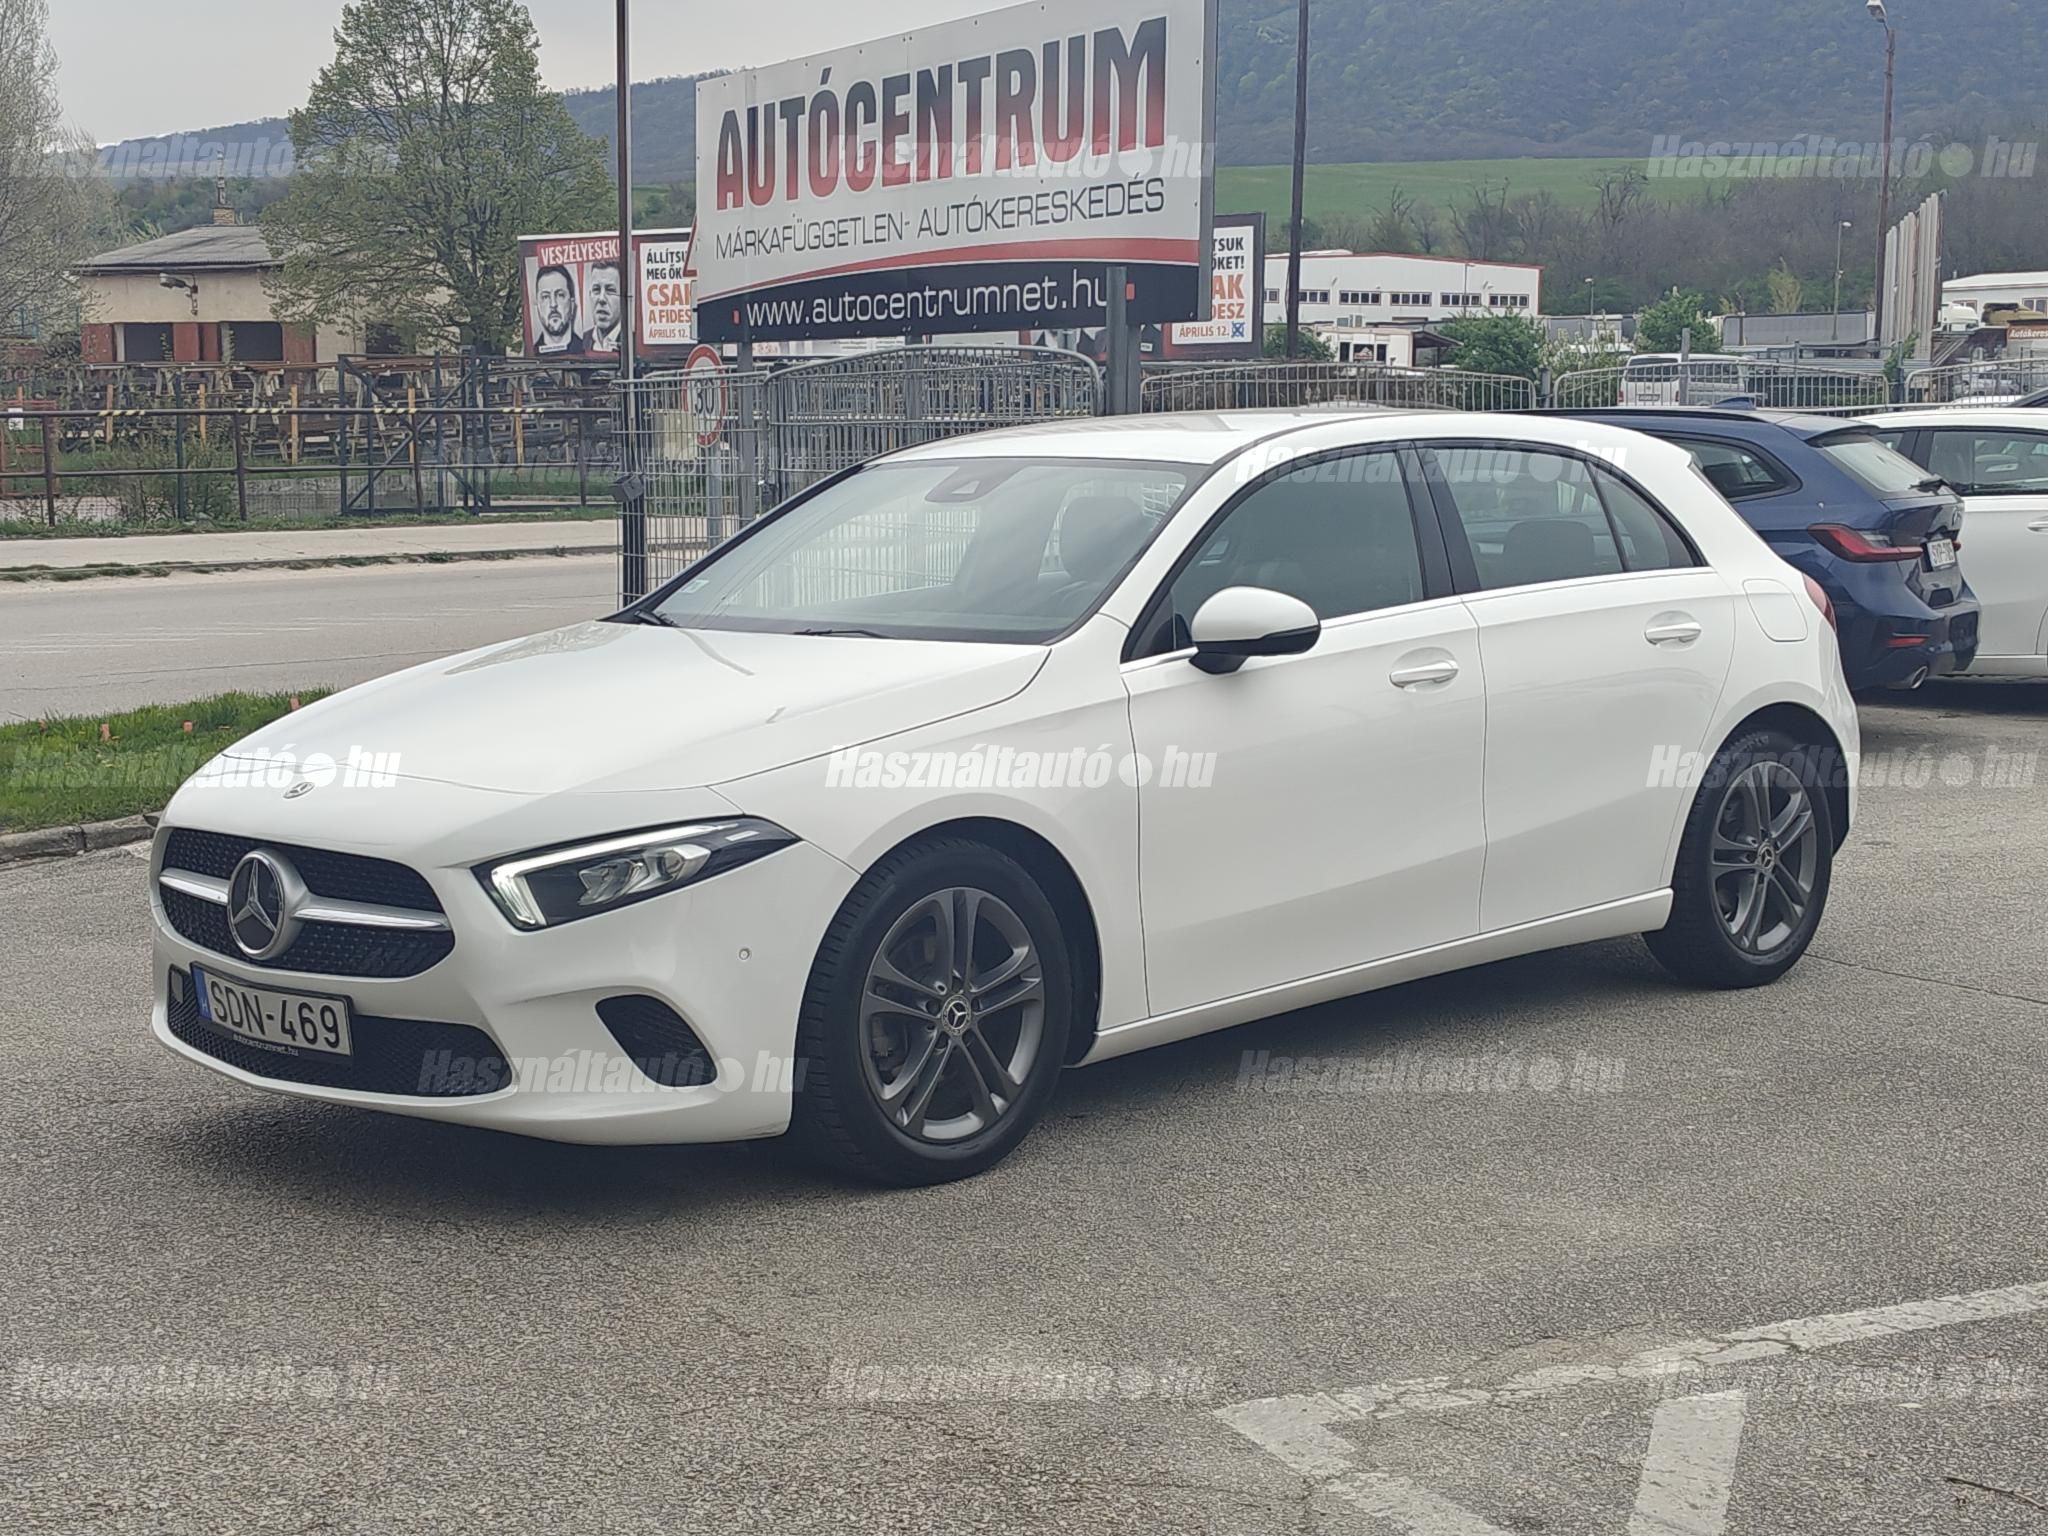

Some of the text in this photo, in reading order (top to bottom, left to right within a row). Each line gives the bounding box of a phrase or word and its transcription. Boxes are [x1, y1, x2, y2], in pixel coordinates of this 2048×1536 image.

[716, 16, 1168, 211] AUTÓCENTRUM
[917, 173, 1165, 239] AUTÓKERESKEDÉS
[1213, 237, 1244, 252] TSUK
[646, 263, 683, 280] MEG ŐK
[1212, 273, 1244, 300] AK
[649, 309, 691, 324] A FIDES
[1212, 303, 1245, 319] DESZ
[649, 327, 676, 339] ÁPRILIS
[1179, 325, 1230, 338] ÁPRILIS 12.
[695, 380, 715, 414] 30
[210, 980, 340, 1049] SDN-469
